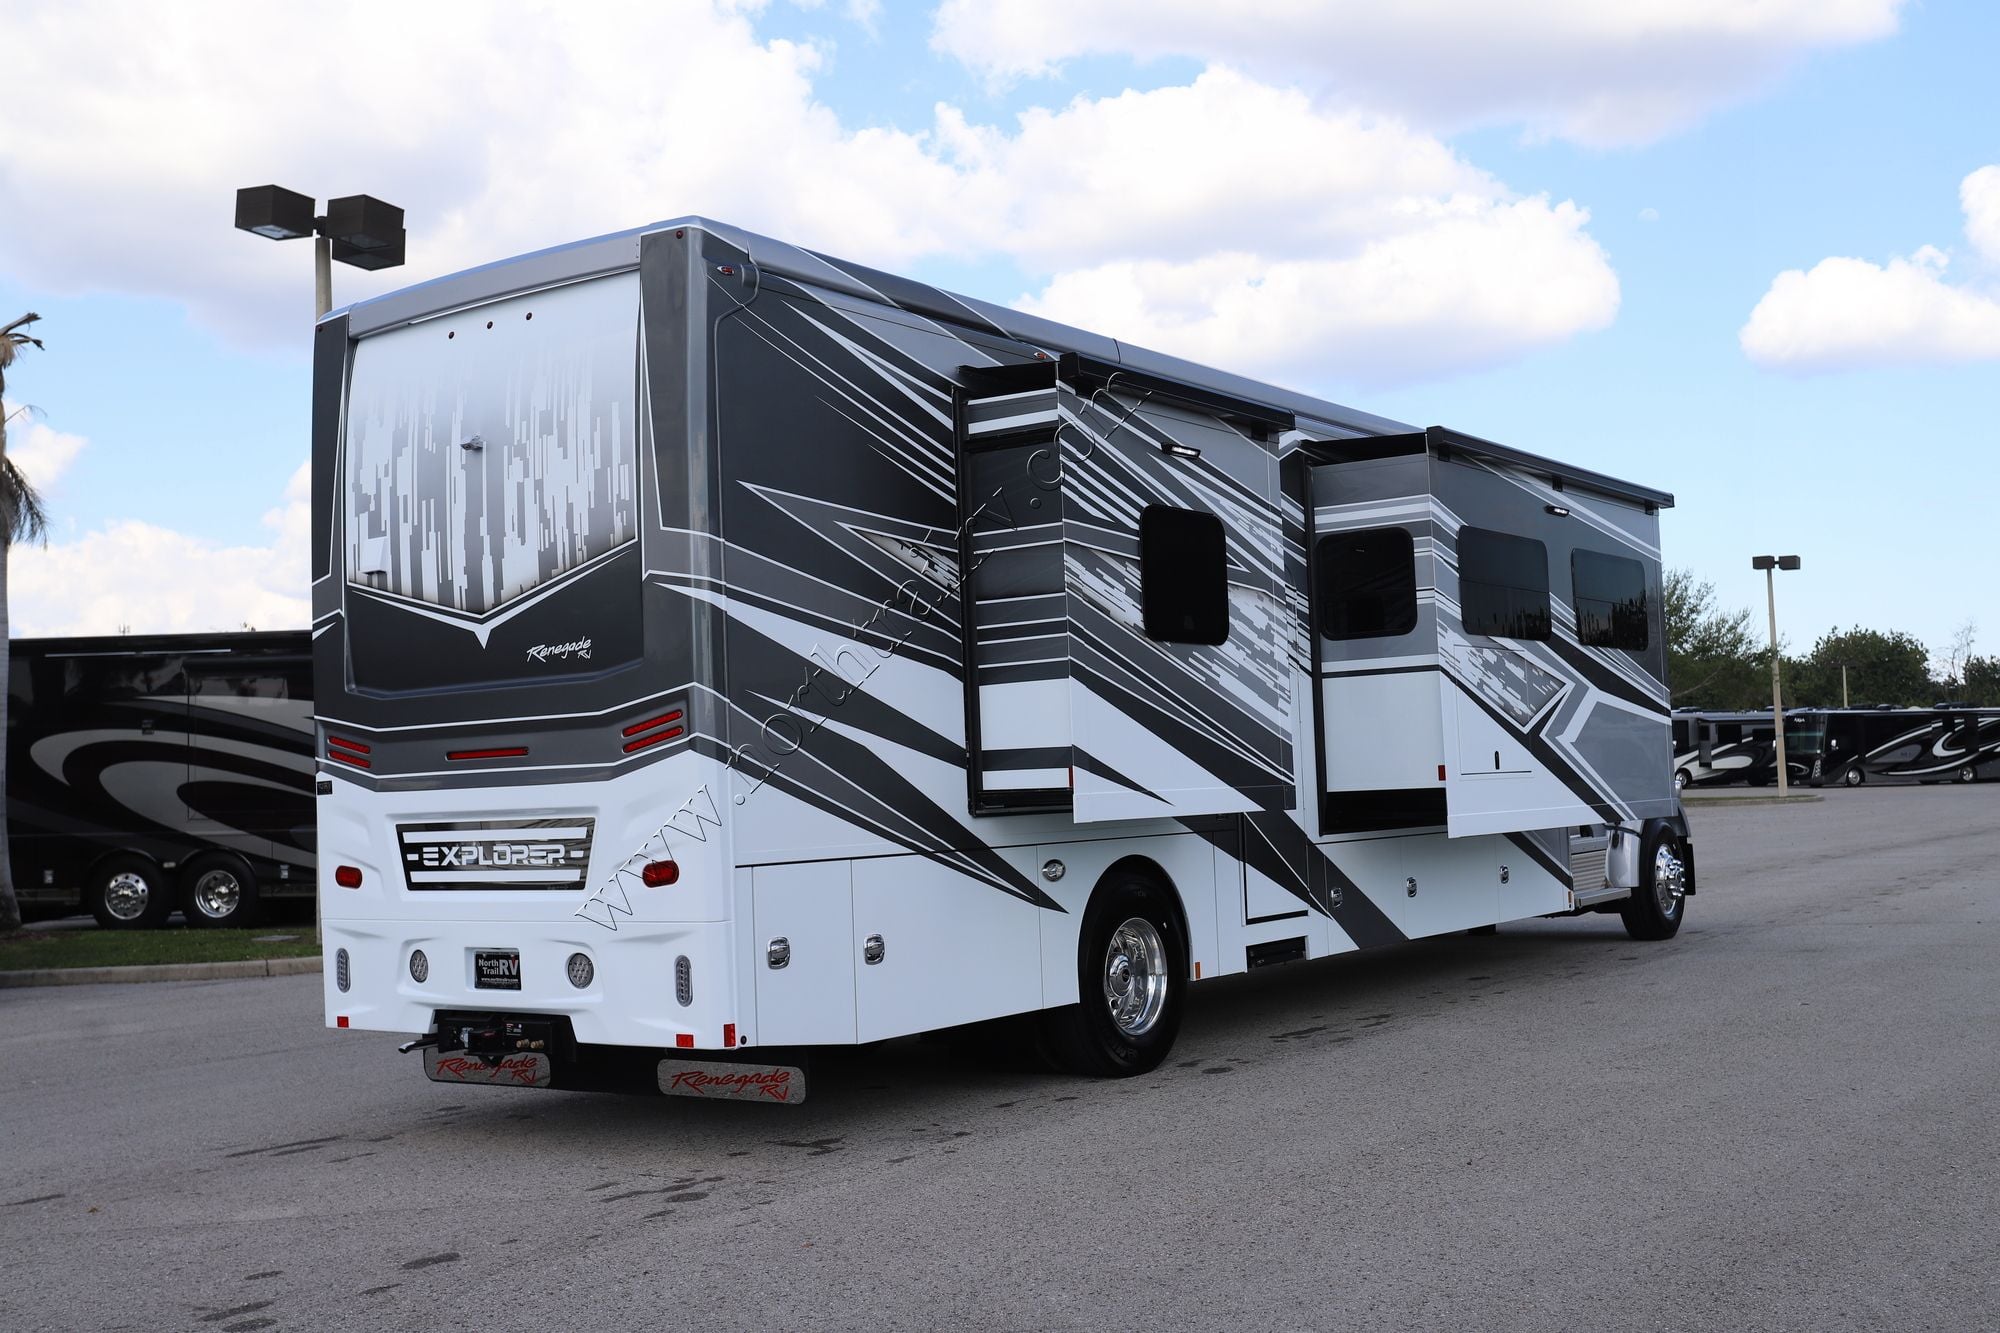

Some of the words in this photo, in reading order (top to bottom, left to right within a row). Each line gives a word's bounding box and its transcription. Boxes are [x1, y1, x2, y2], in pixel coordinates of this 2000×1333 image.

[526, 635, 592, 663] Renegade
[577, 649, 592, 659] RV
[422, 844, 566, 867] EXPLORER
[478, 958, 499, 967] North
[499, 959, 519, 975] RV
[482, 967, 499, 975] Trail
[511, 1069, 537, 1084] RV
[671, 1068, 790, 1095] Renegade
[759, 1083, 789, 1101] RV
